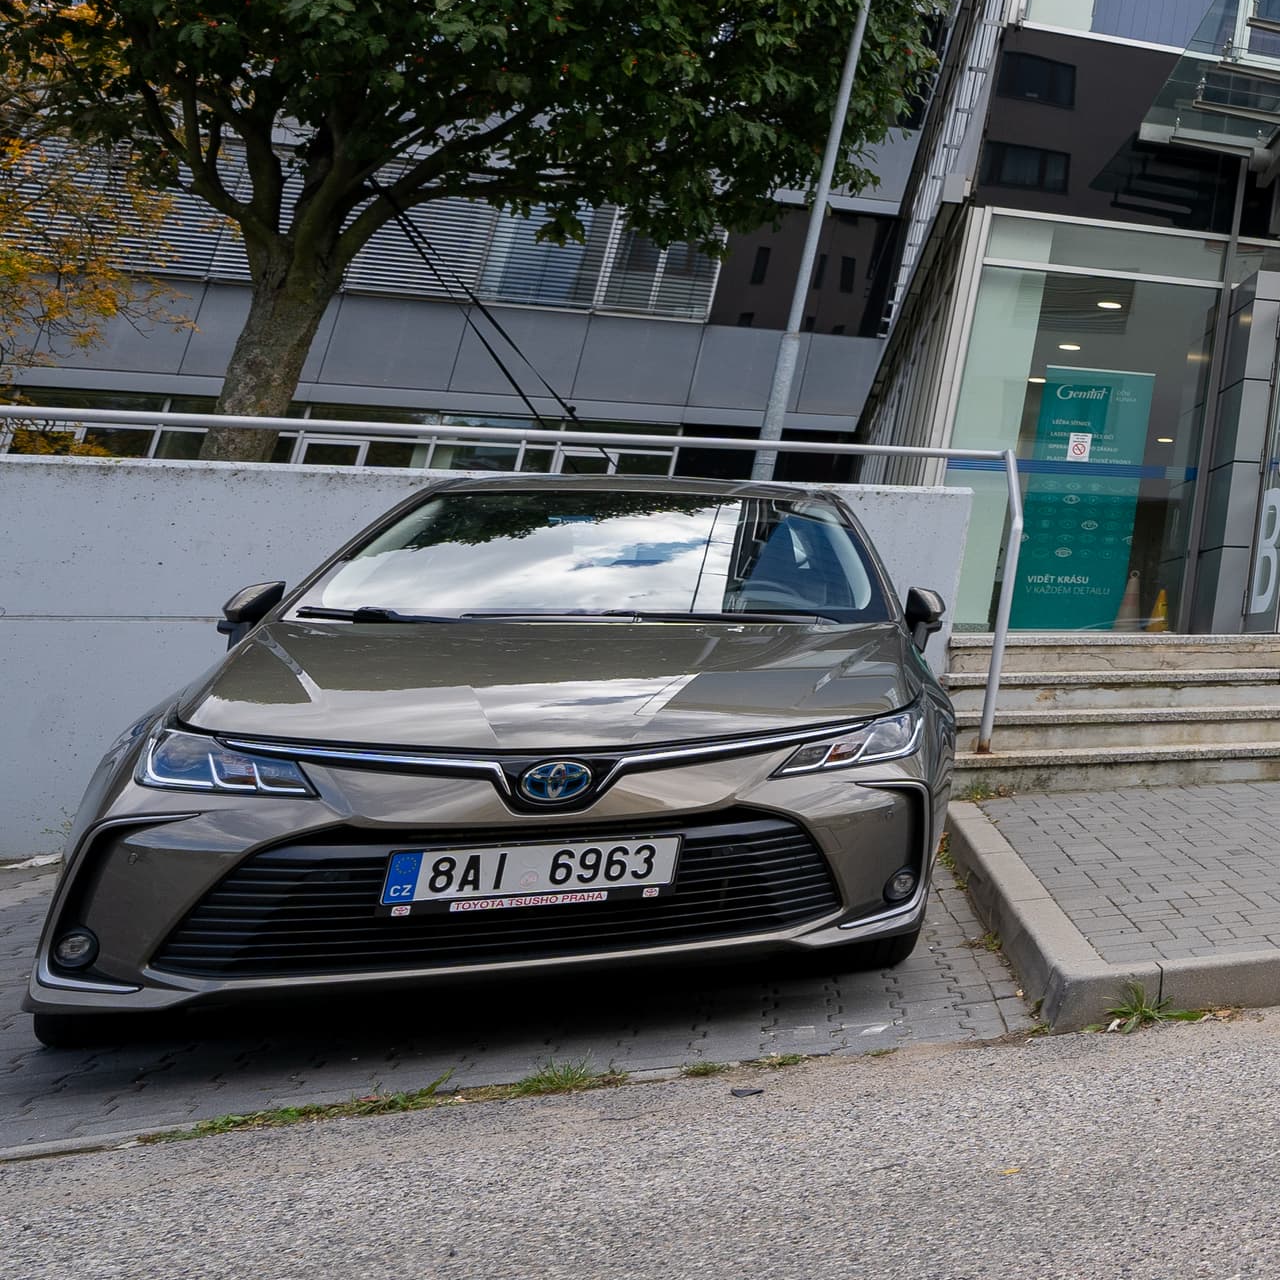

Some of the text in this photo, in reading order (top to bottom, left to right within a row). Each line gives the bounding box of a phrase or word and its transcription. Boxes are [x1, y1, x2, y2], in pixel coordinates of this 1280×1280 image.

[1056, 384, 1108, 400] Gemini
[1027, 574, 1089, 584] VIDĚT KRÁSU
[428, 844, 657, 894] 8AI 6963
[389, 884, 411, 897] CZ
[454, 892, 605, 911] TOYOTA TSUSHO PRAHA
